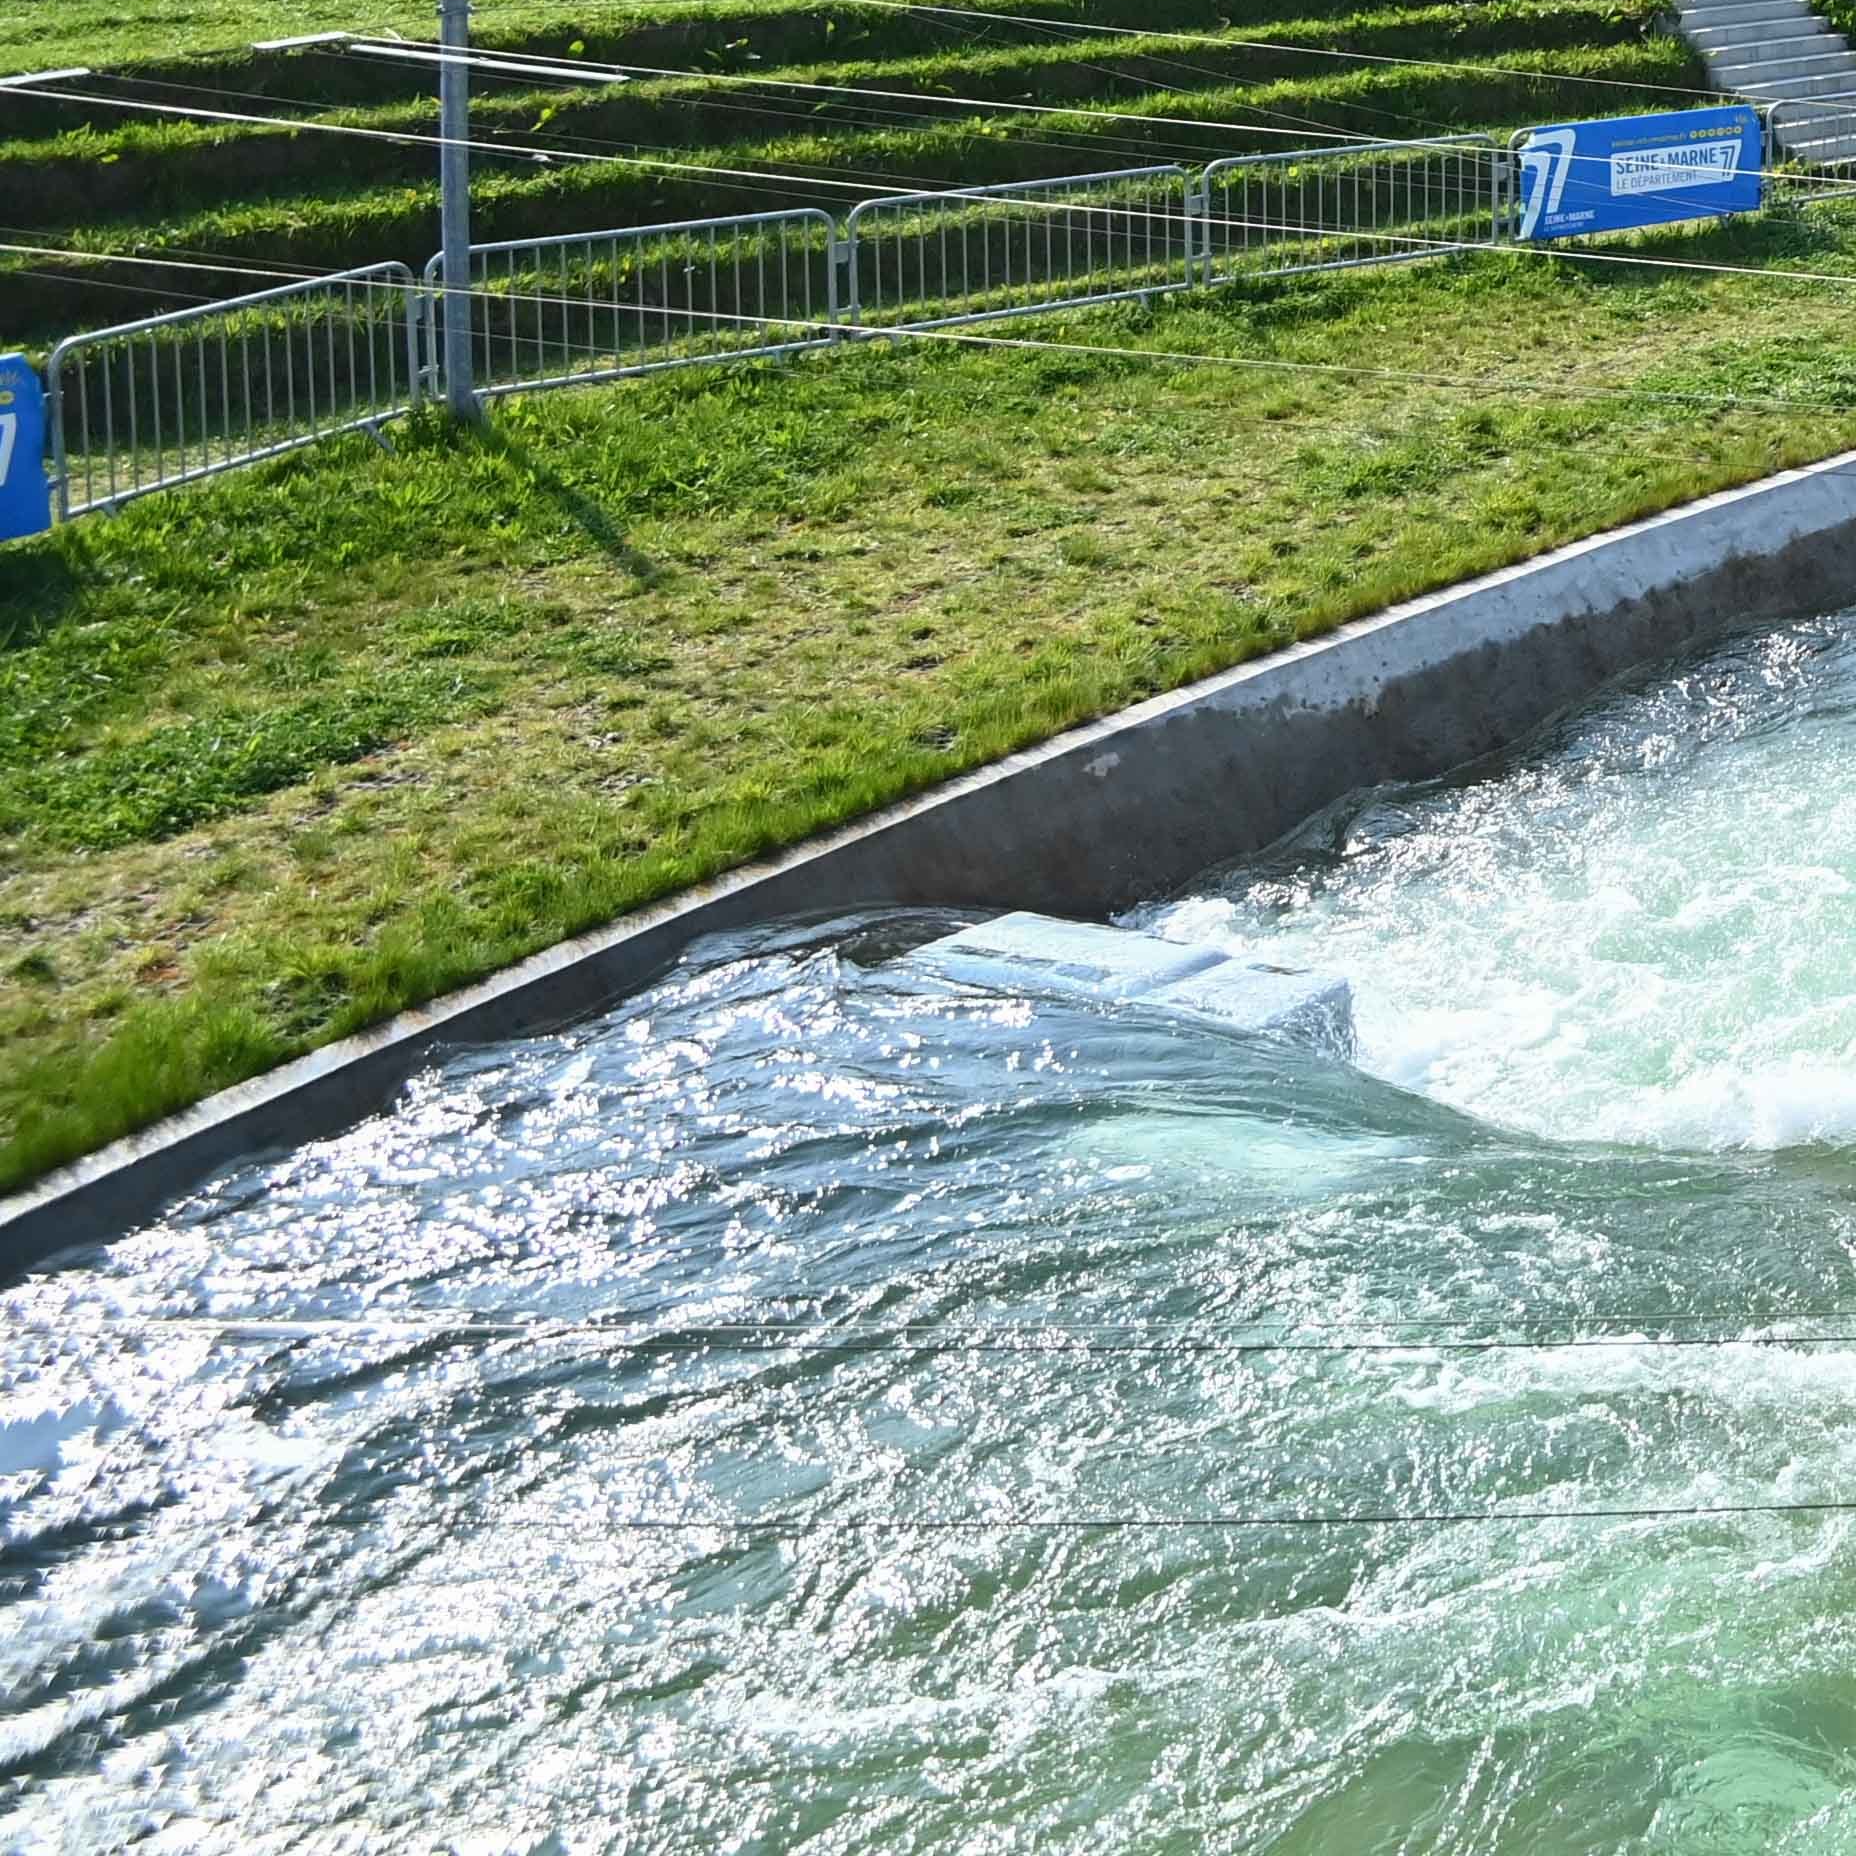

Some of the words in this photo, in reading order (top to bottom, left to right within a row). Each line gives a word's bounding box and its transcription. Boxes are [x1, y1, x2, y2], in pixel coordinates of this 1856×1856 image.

[1616, 153, 1659, 175] SEINE
[1667, 146, 1718, 167] MARNE
[1616, 177, 1629, 190] LE
